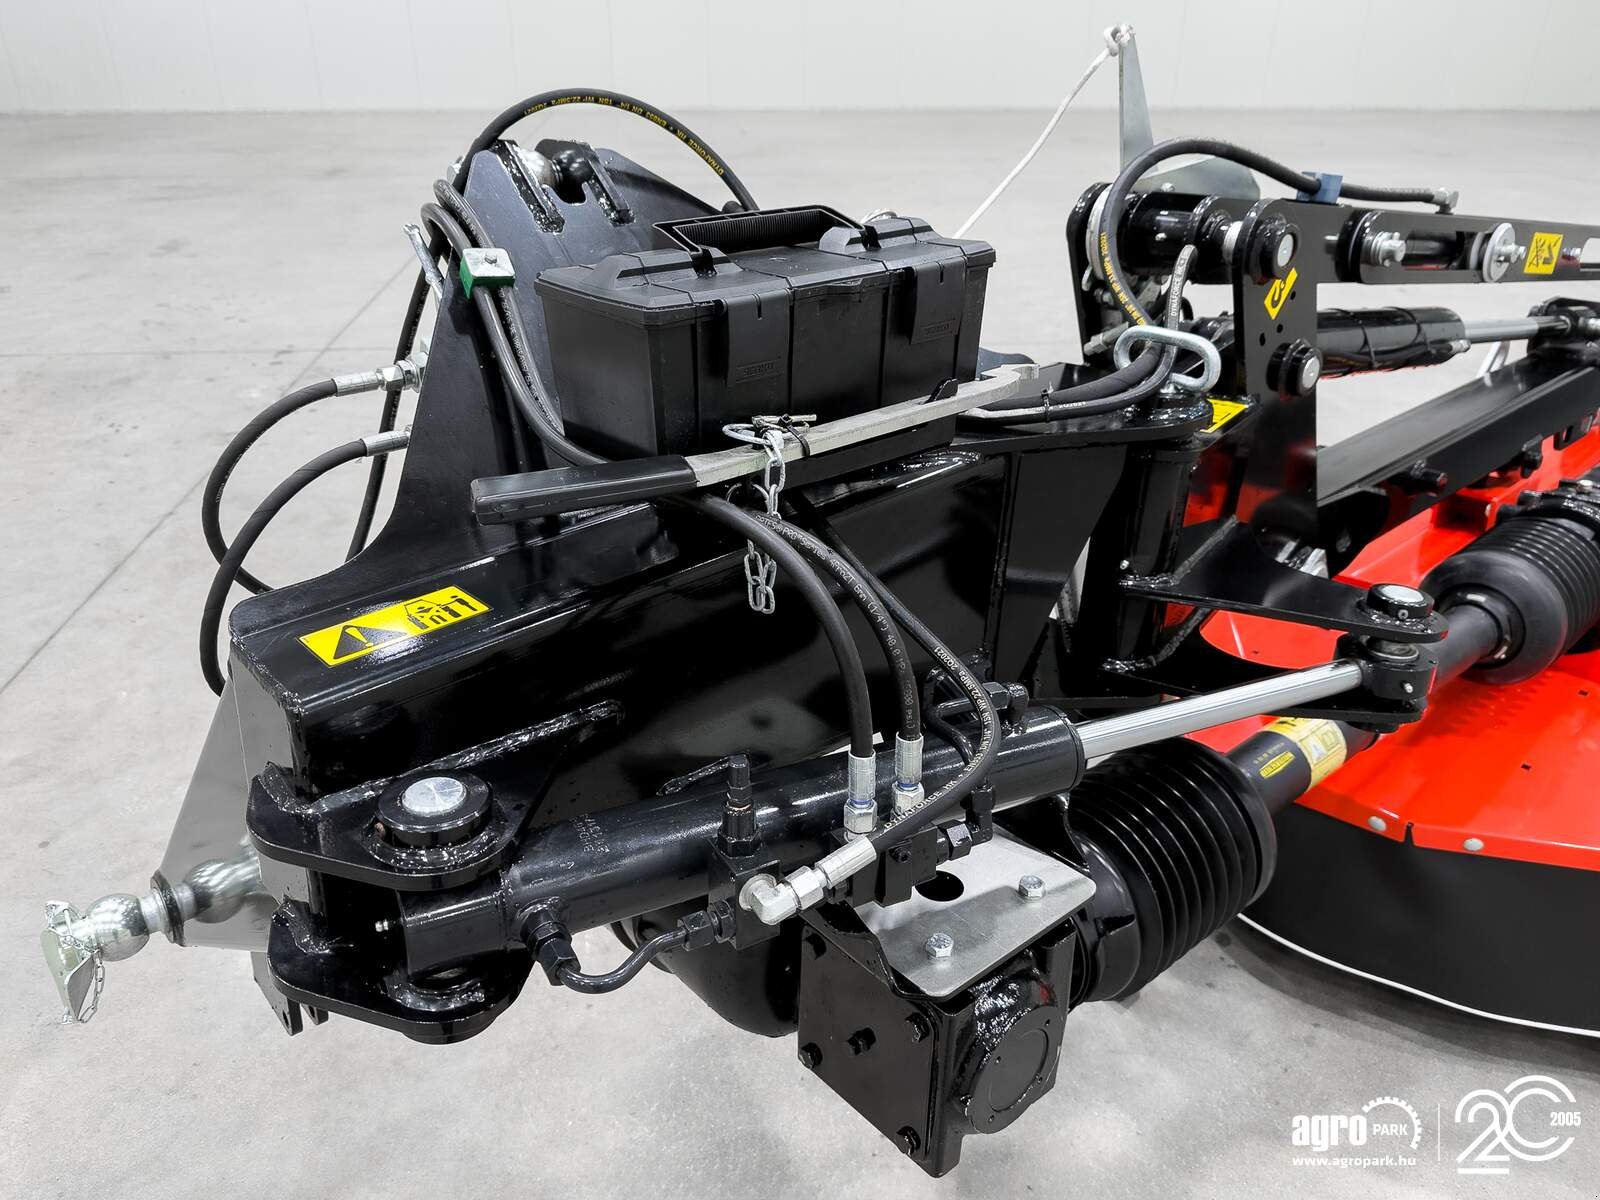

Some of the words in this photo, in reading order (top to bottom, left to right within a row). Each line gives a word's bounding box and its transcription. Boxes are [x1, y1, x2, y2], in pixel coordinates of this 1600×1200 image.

[688, 137, 725, 177] DYNAFORCE
[1171, 277, 1181, 317] DYNAFORCE
[933, 646, 958, 671] 2Q2021
[959, 670, 982, 699] 22.5MPa
[884, 790, 942, 829] DYNAFORCE
